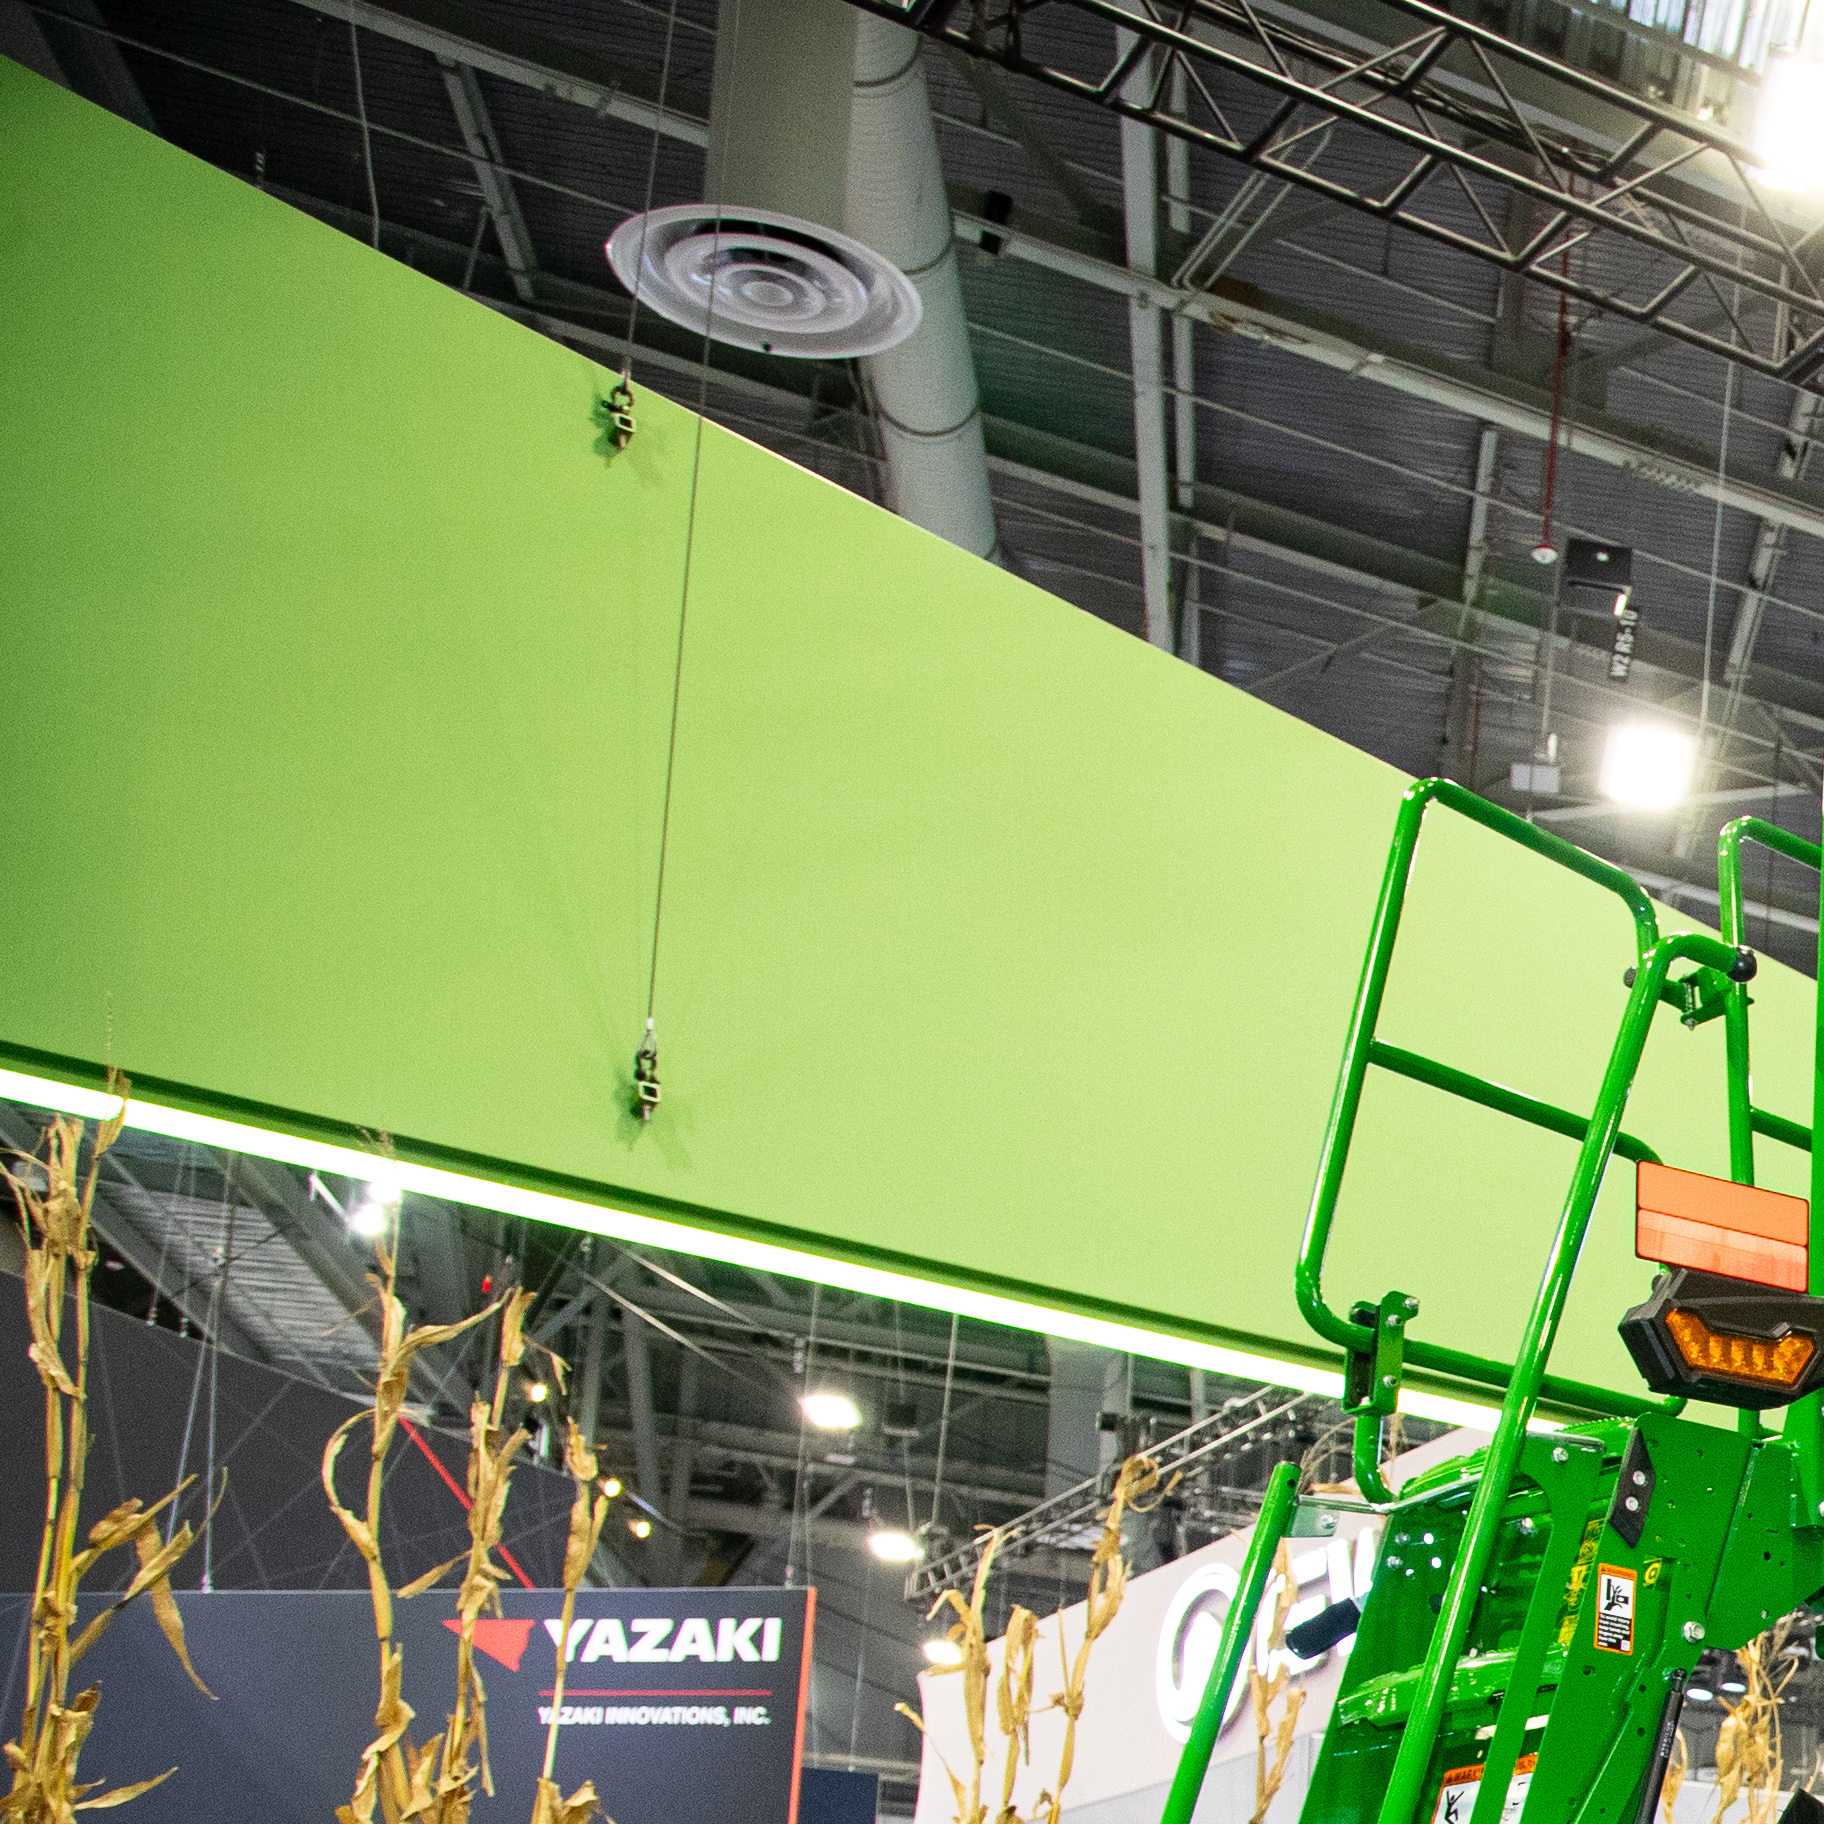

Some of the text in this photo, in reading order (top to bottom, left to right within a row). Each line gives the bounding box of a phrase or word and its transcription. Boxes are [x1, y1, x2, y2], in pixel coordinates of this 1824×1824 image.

[543, 1617, 783, 1664] YAZAKI
[537, 1706, 772, 1728] YAZAKI INNOVATIONS, INC.
